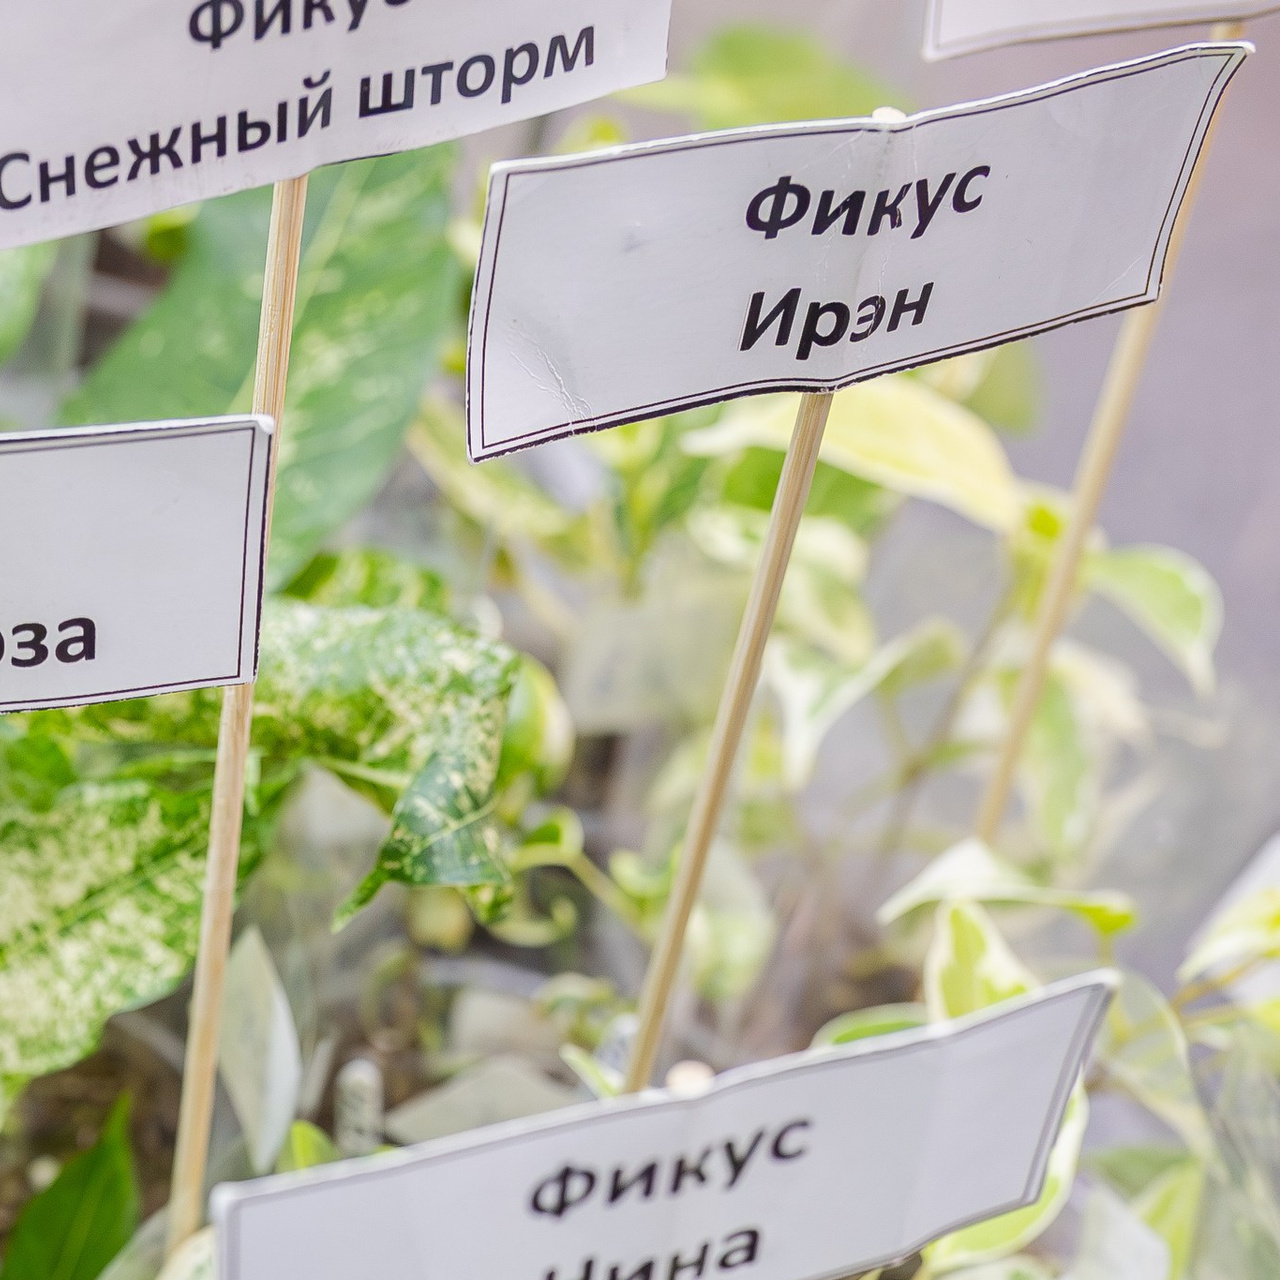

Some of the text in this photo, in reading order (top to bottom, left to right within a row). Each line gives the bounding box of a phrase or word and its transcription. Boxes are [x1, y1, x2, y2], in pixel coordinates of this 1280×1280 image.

[189, 0, 412, 50] Фику
[358, 25, 597, 119] шторм
[744, 162, 992, 241] Фикус
[738, 281, 935, 361] Ирэн
[527, 1116, 813, 1221] Фикус
